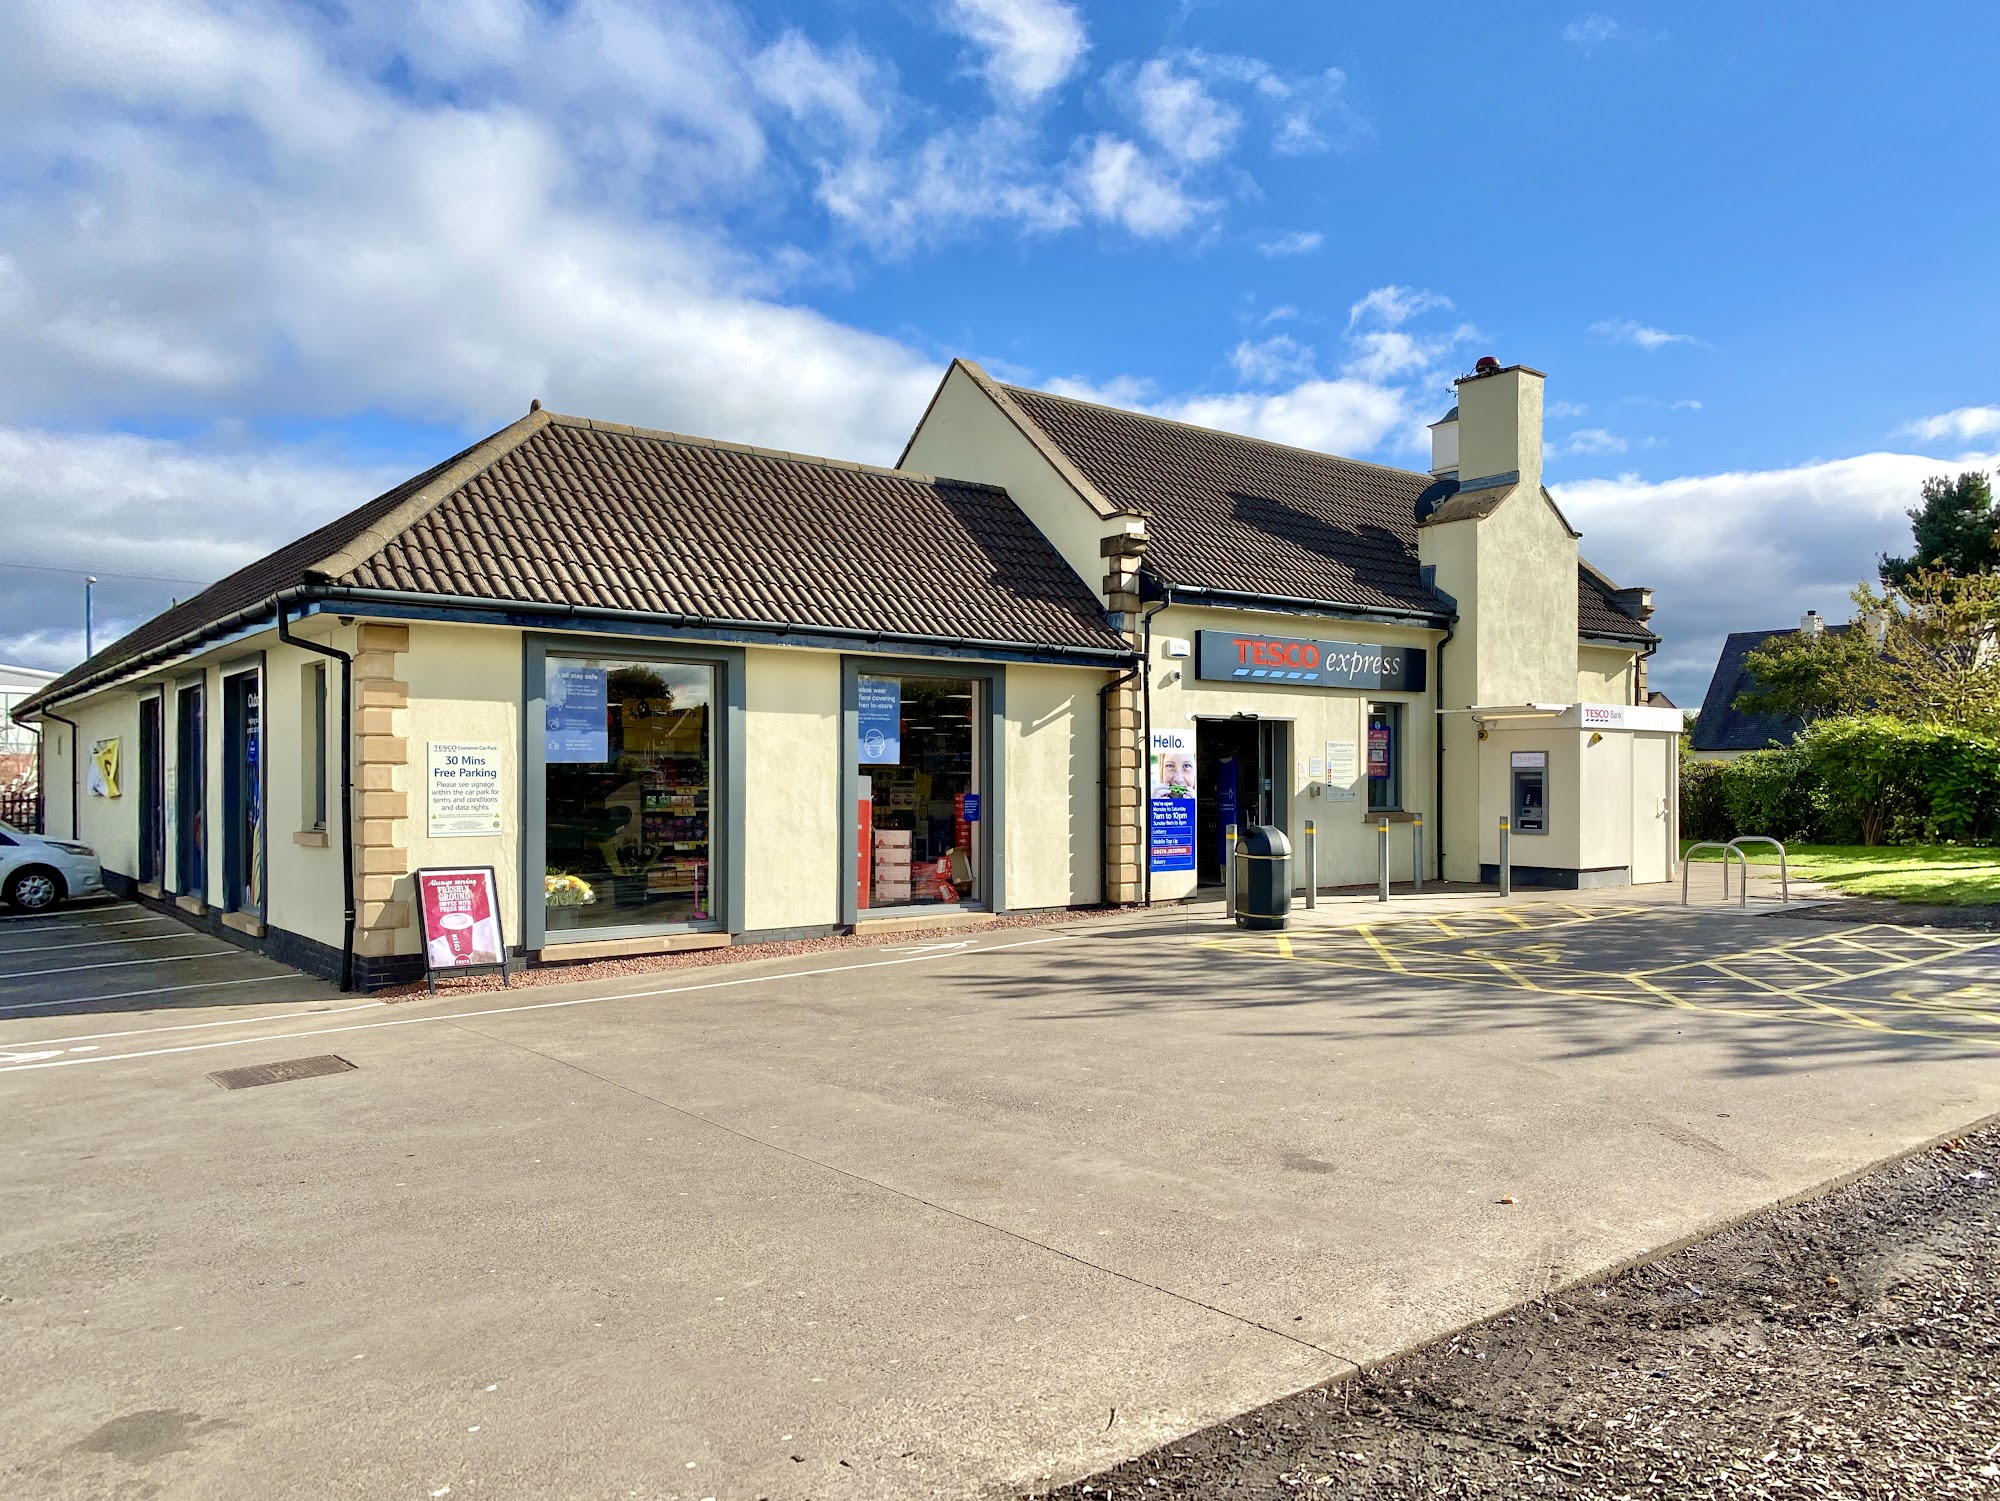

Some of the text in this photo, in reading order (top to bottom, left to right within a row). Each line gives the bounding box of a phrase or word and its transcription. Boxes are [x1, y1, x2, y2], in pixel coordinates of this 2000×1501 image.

[1232, 639, 1400, 681] TESCO express
[872, 695, 896, 703] covering
[1585, 709, 1622, 718] TESCO Bank
[1154, 734, 1184, 748] Hello.
[446, 756, 486, 765] 30 Mins
[434, 768, 496, 779] Free Parking
[1172, 812, 1188, 820] 10pm
[437, 885, 470, 894] FRESHLY
[438, 892, 470, 902] GROUND
